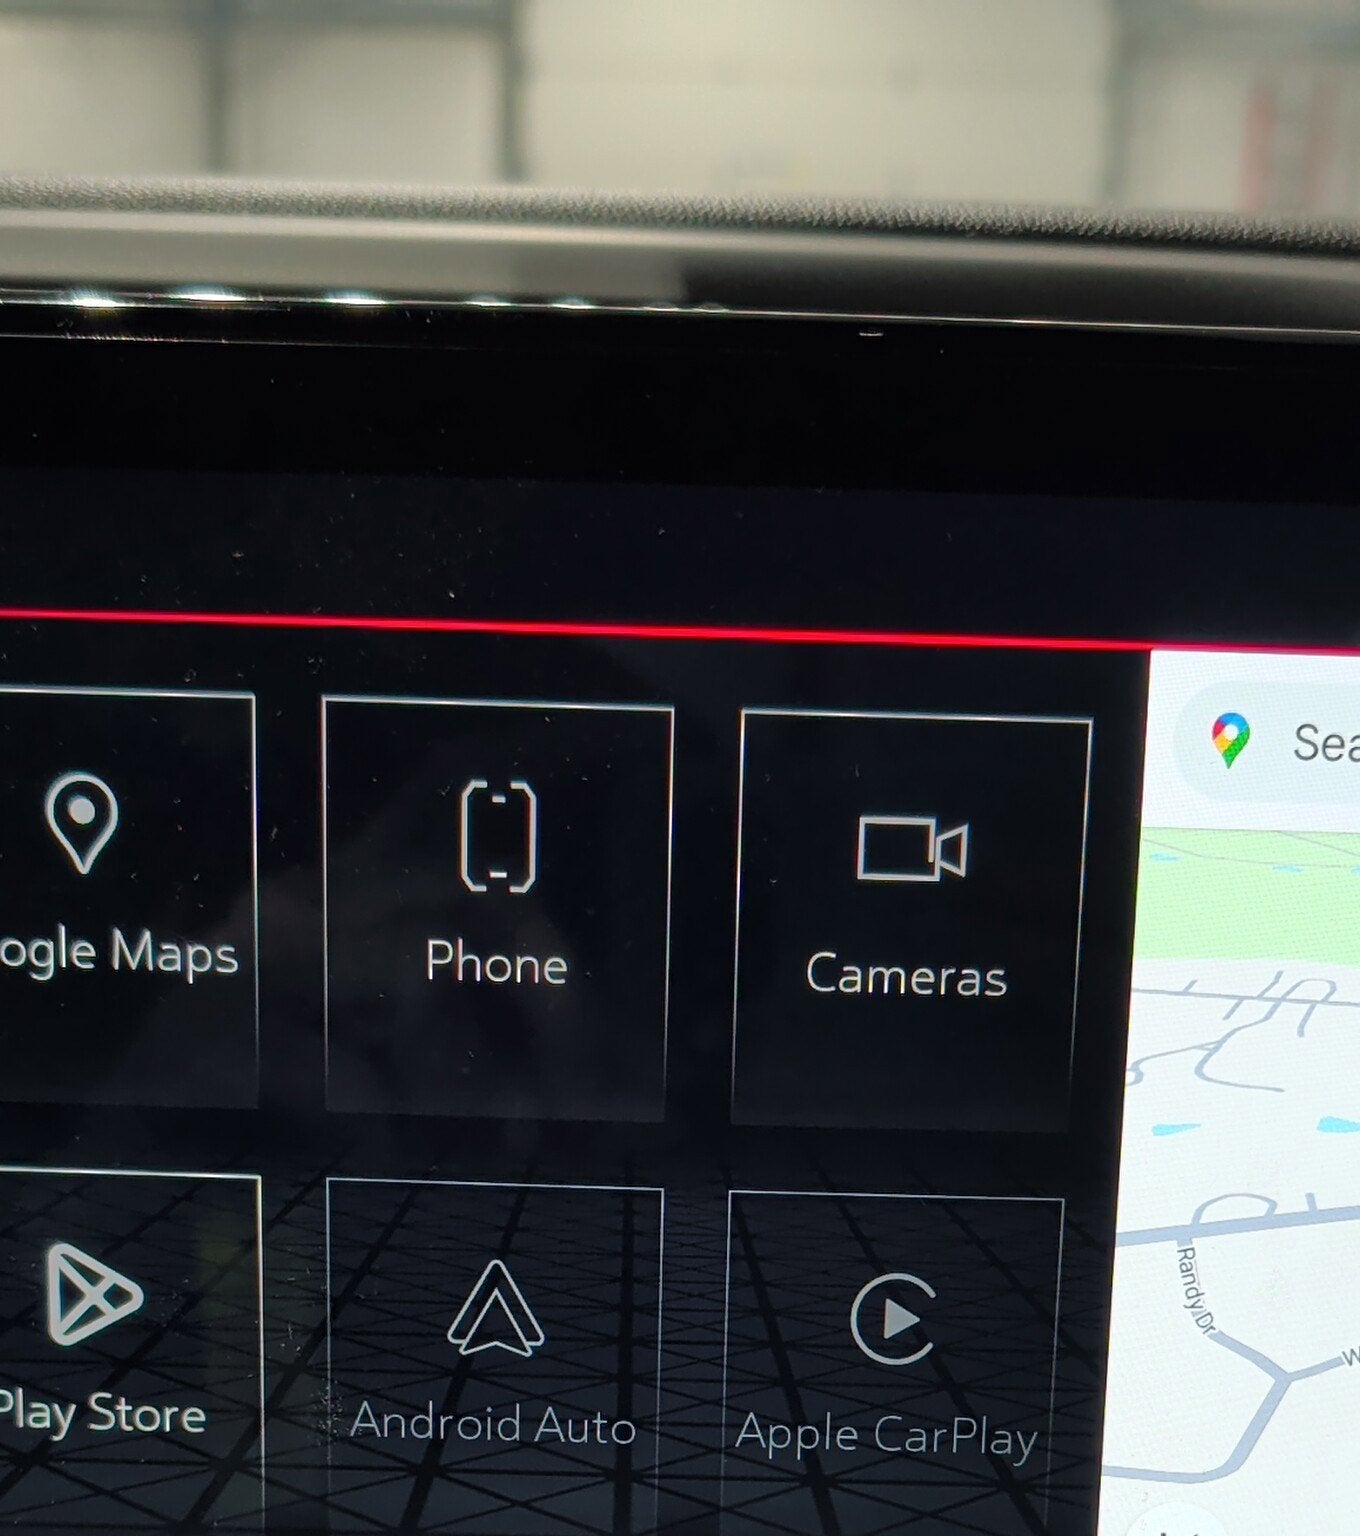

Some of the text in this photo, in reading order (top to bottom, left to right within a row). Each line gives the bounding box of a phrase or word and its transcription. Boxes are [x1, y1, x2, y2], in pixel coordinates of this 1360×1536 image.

[112, 930, 240, 986] Maps
[426, 940, 569, 987] Phone
[806, 951, 1009, 998] Cameras
[1177, 1246, 1218, 1336] Randy Dr
[88, 1391, 207, 1436] Store
[350, 1400, 637, 1446] Android Auto
[735, 1411, 1039, 1467] Apple CarPlay
